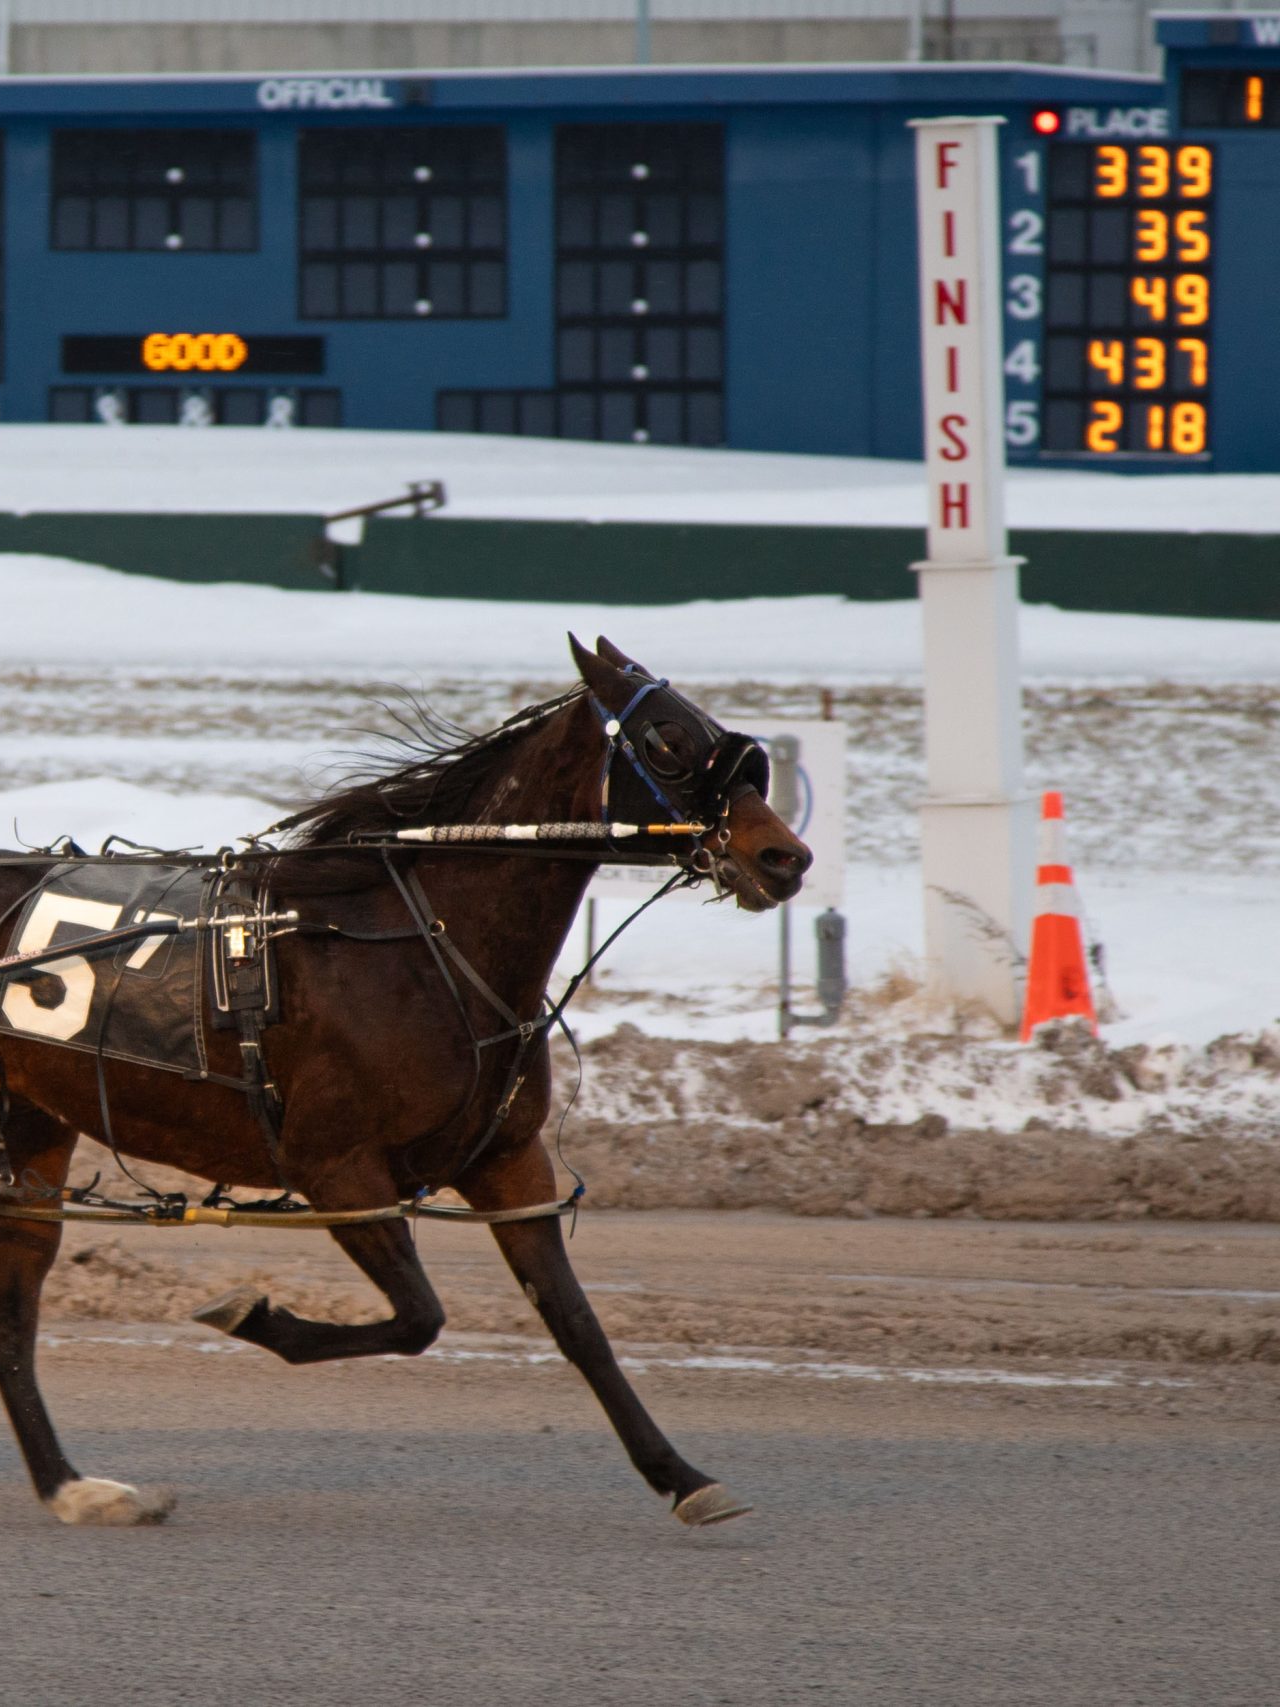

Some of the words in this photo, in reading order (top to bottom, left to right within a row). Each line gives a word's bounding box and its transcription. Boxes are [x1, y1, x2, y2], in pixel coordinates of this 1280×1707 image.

[257, 79, 391, 109] OFFICIAL
[1068, 108, 1169, 137] PLACE
[1015, 151, 1039, 193] 1
[1095, 145, 1213, 199] 339
[1010, 209, 1043, 255] 2
[1136, 209, 1211, 263] 35
[1007, 274, 1041, 319] 3
[1130, 273, 1210, 327] 49
[933, 141, 971, 529] FINISH
[1005, 339, 1040, 384] 4
[1087, 336, 1208, 391] 437
[1006, 400, 1039, 446] 5
[1085, 400, 1207, 456] 218
[1, 890, 124, 1042] 5
